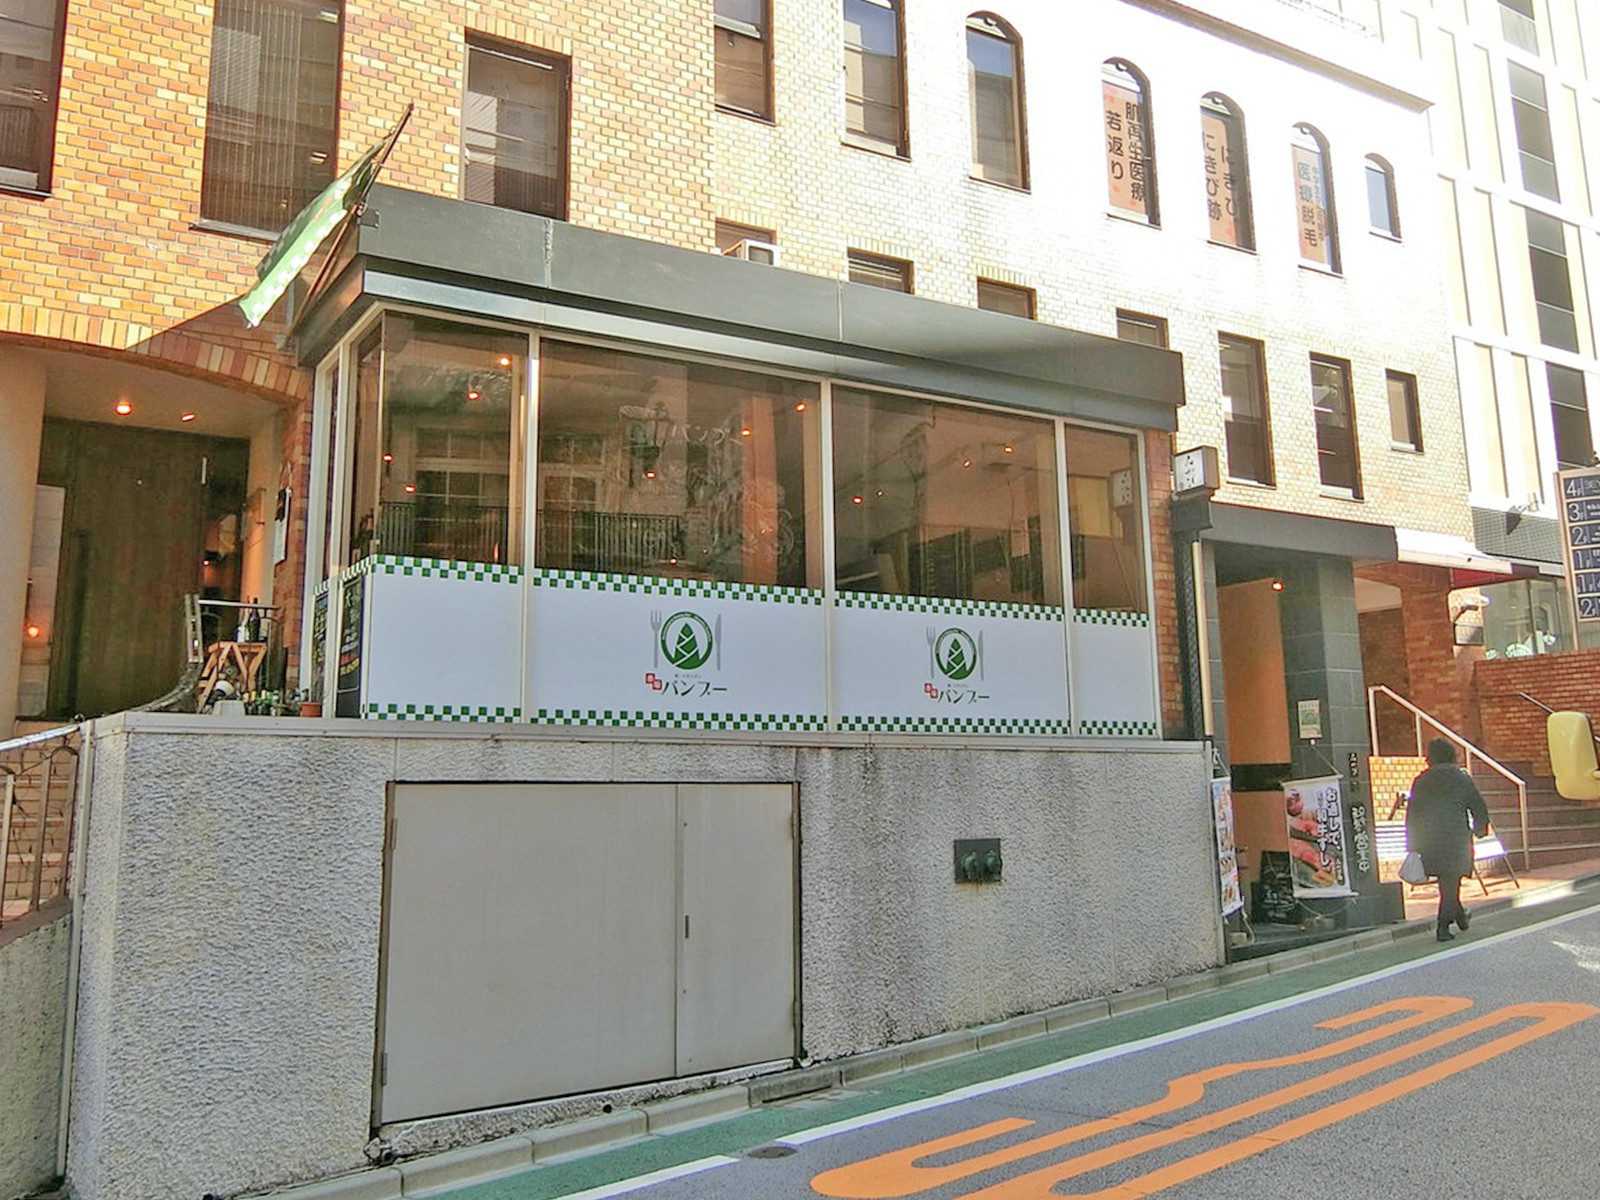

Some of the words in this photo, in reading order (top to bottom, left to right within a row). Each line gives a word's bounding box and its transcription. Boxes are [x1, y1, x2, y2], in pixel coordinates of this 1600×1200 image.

[1106, 110, 1124, 180] 若返り
[1125, 102, 1146, 202] 肌再生医療
[1204, 133, 1222, 221] にきび跡
[1298, 161, 1318, 248] 医療脱毛
[661, 680, 728, 698] バンブー
[938, 689, 990, 704] バンブー
